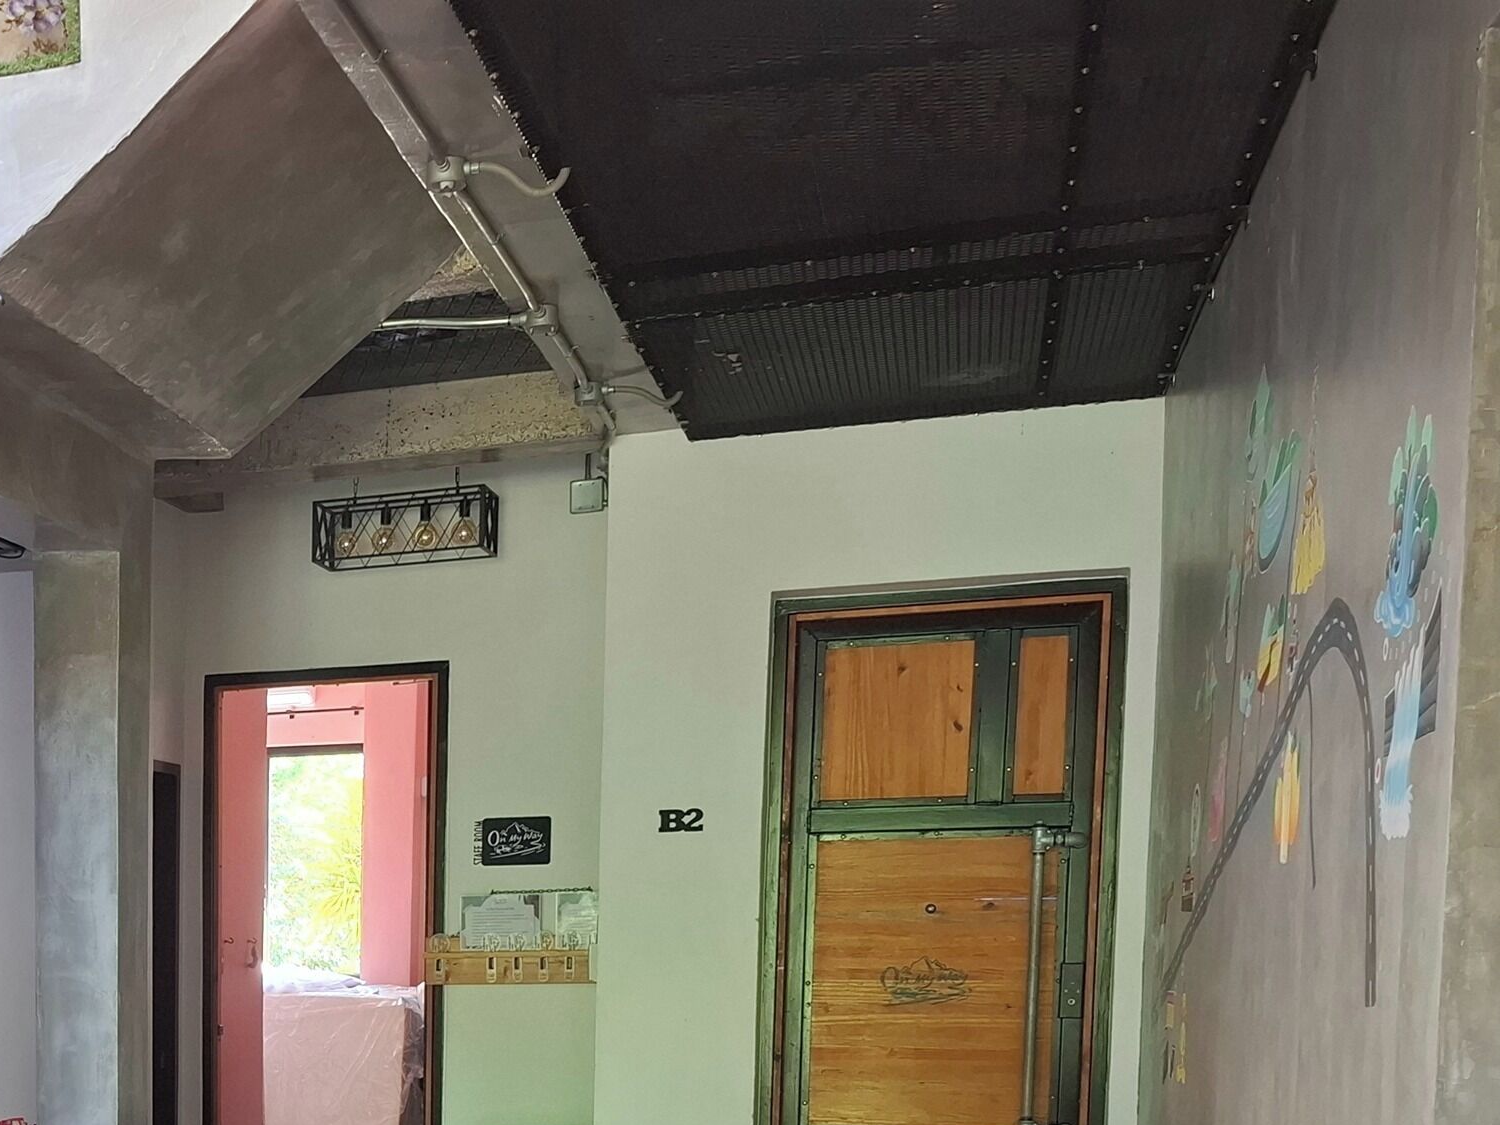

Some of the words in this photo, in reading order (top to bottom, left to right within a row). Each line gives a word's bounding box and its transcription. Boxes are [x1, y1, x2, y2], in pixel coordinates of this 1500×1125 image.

[658, 808, 705, 833] B2
[487, 830, 507, 847] On
[508, 834, 522, 847] My
[523, 831, 543, 844] Way
